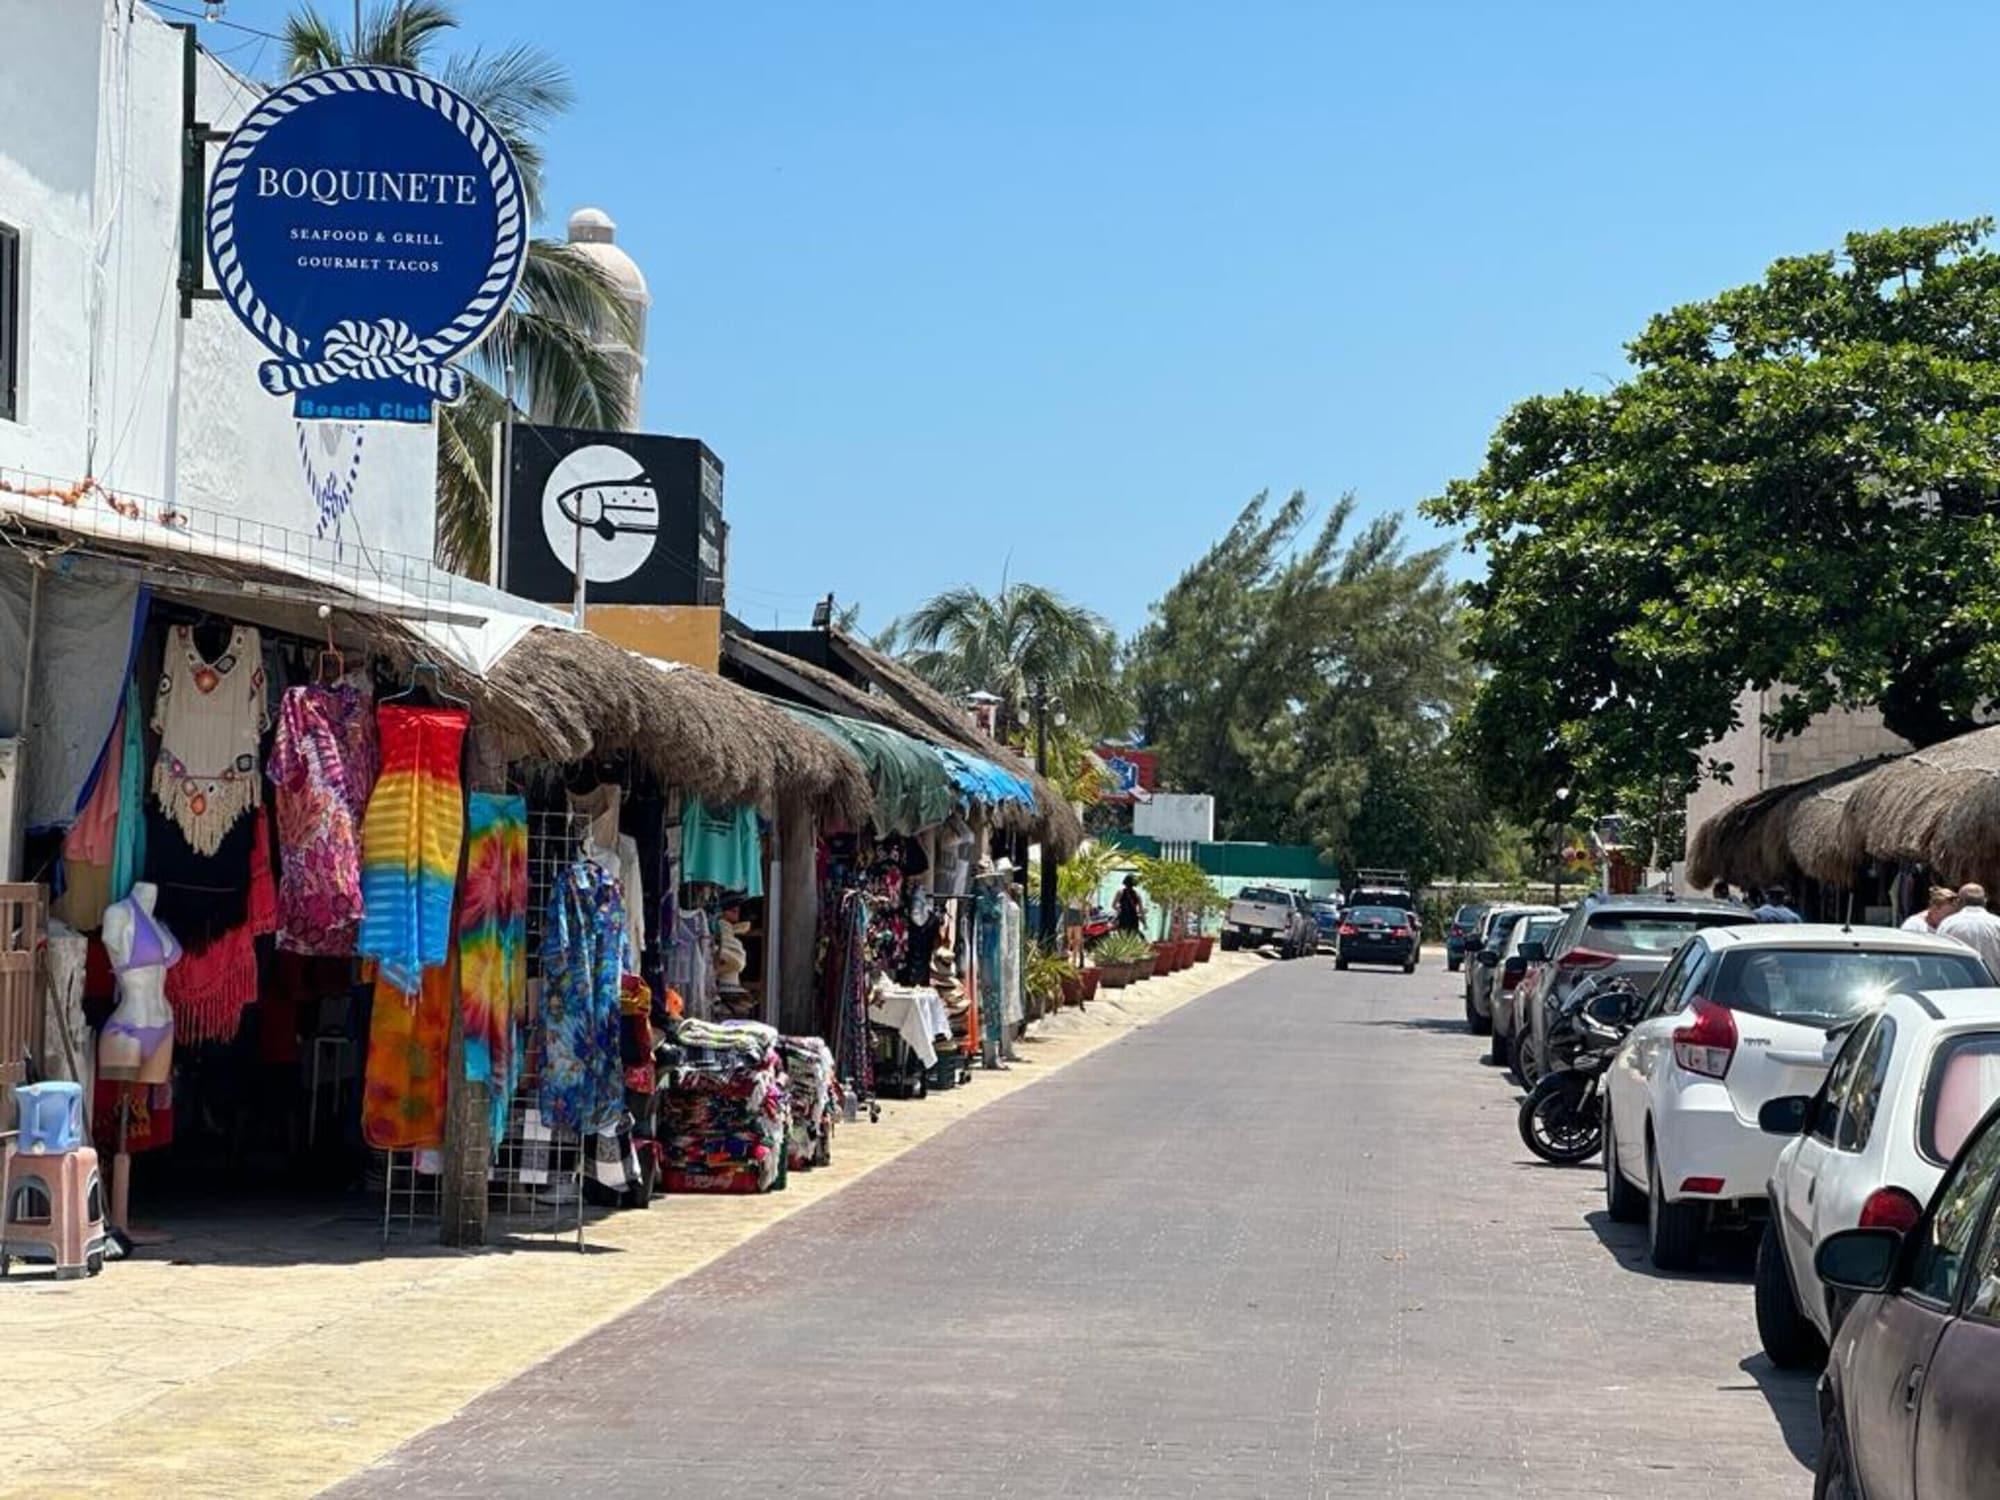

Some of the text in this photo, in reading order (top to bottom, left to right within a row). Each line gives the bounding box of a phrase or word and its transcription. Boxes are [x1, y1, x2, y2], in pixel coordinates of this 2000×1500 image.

[257, 167, 477, 206] BOQUINETE
[290, 228, 444, 245] SEAFOOD & GRILL
[297, 255, 439, 272] GOURMET TACOS
[301, 400, 430, 420] Beach Club
